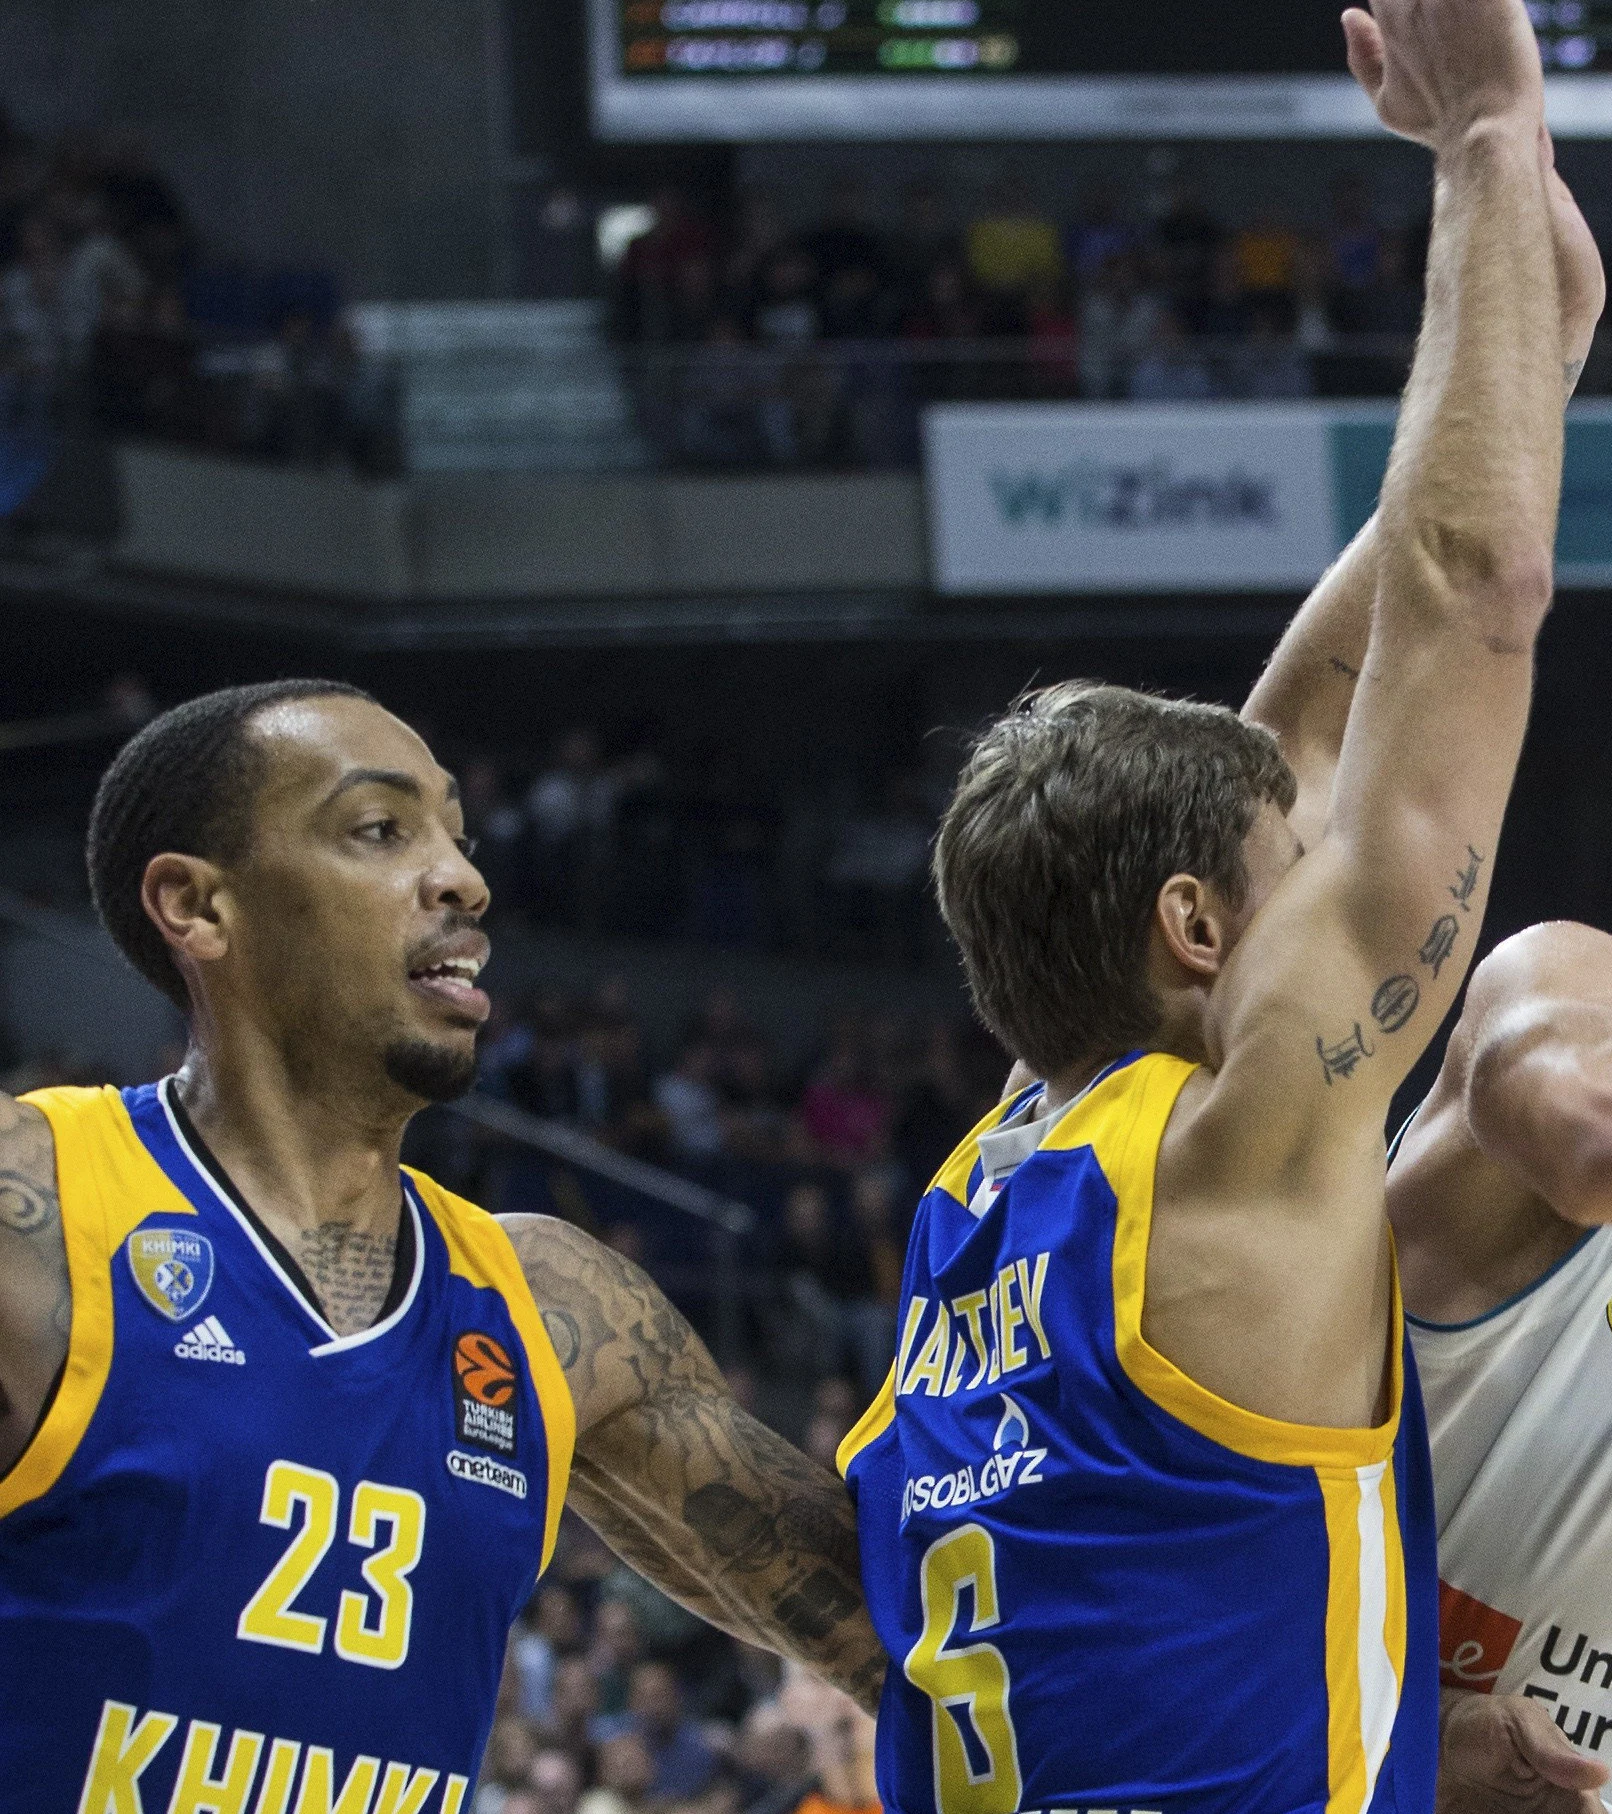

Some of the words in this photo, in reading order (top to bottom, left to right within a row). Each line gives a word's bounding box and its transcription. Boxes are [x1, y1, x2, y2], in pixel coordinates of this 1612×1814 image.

[173, 1342, 246, 1366] adidas
[901, 1448, 1048, 1521] OSOBLGAZ
[236, 1459, 426, 1670] 23
[903, 1523, 1023, 1814] 6
